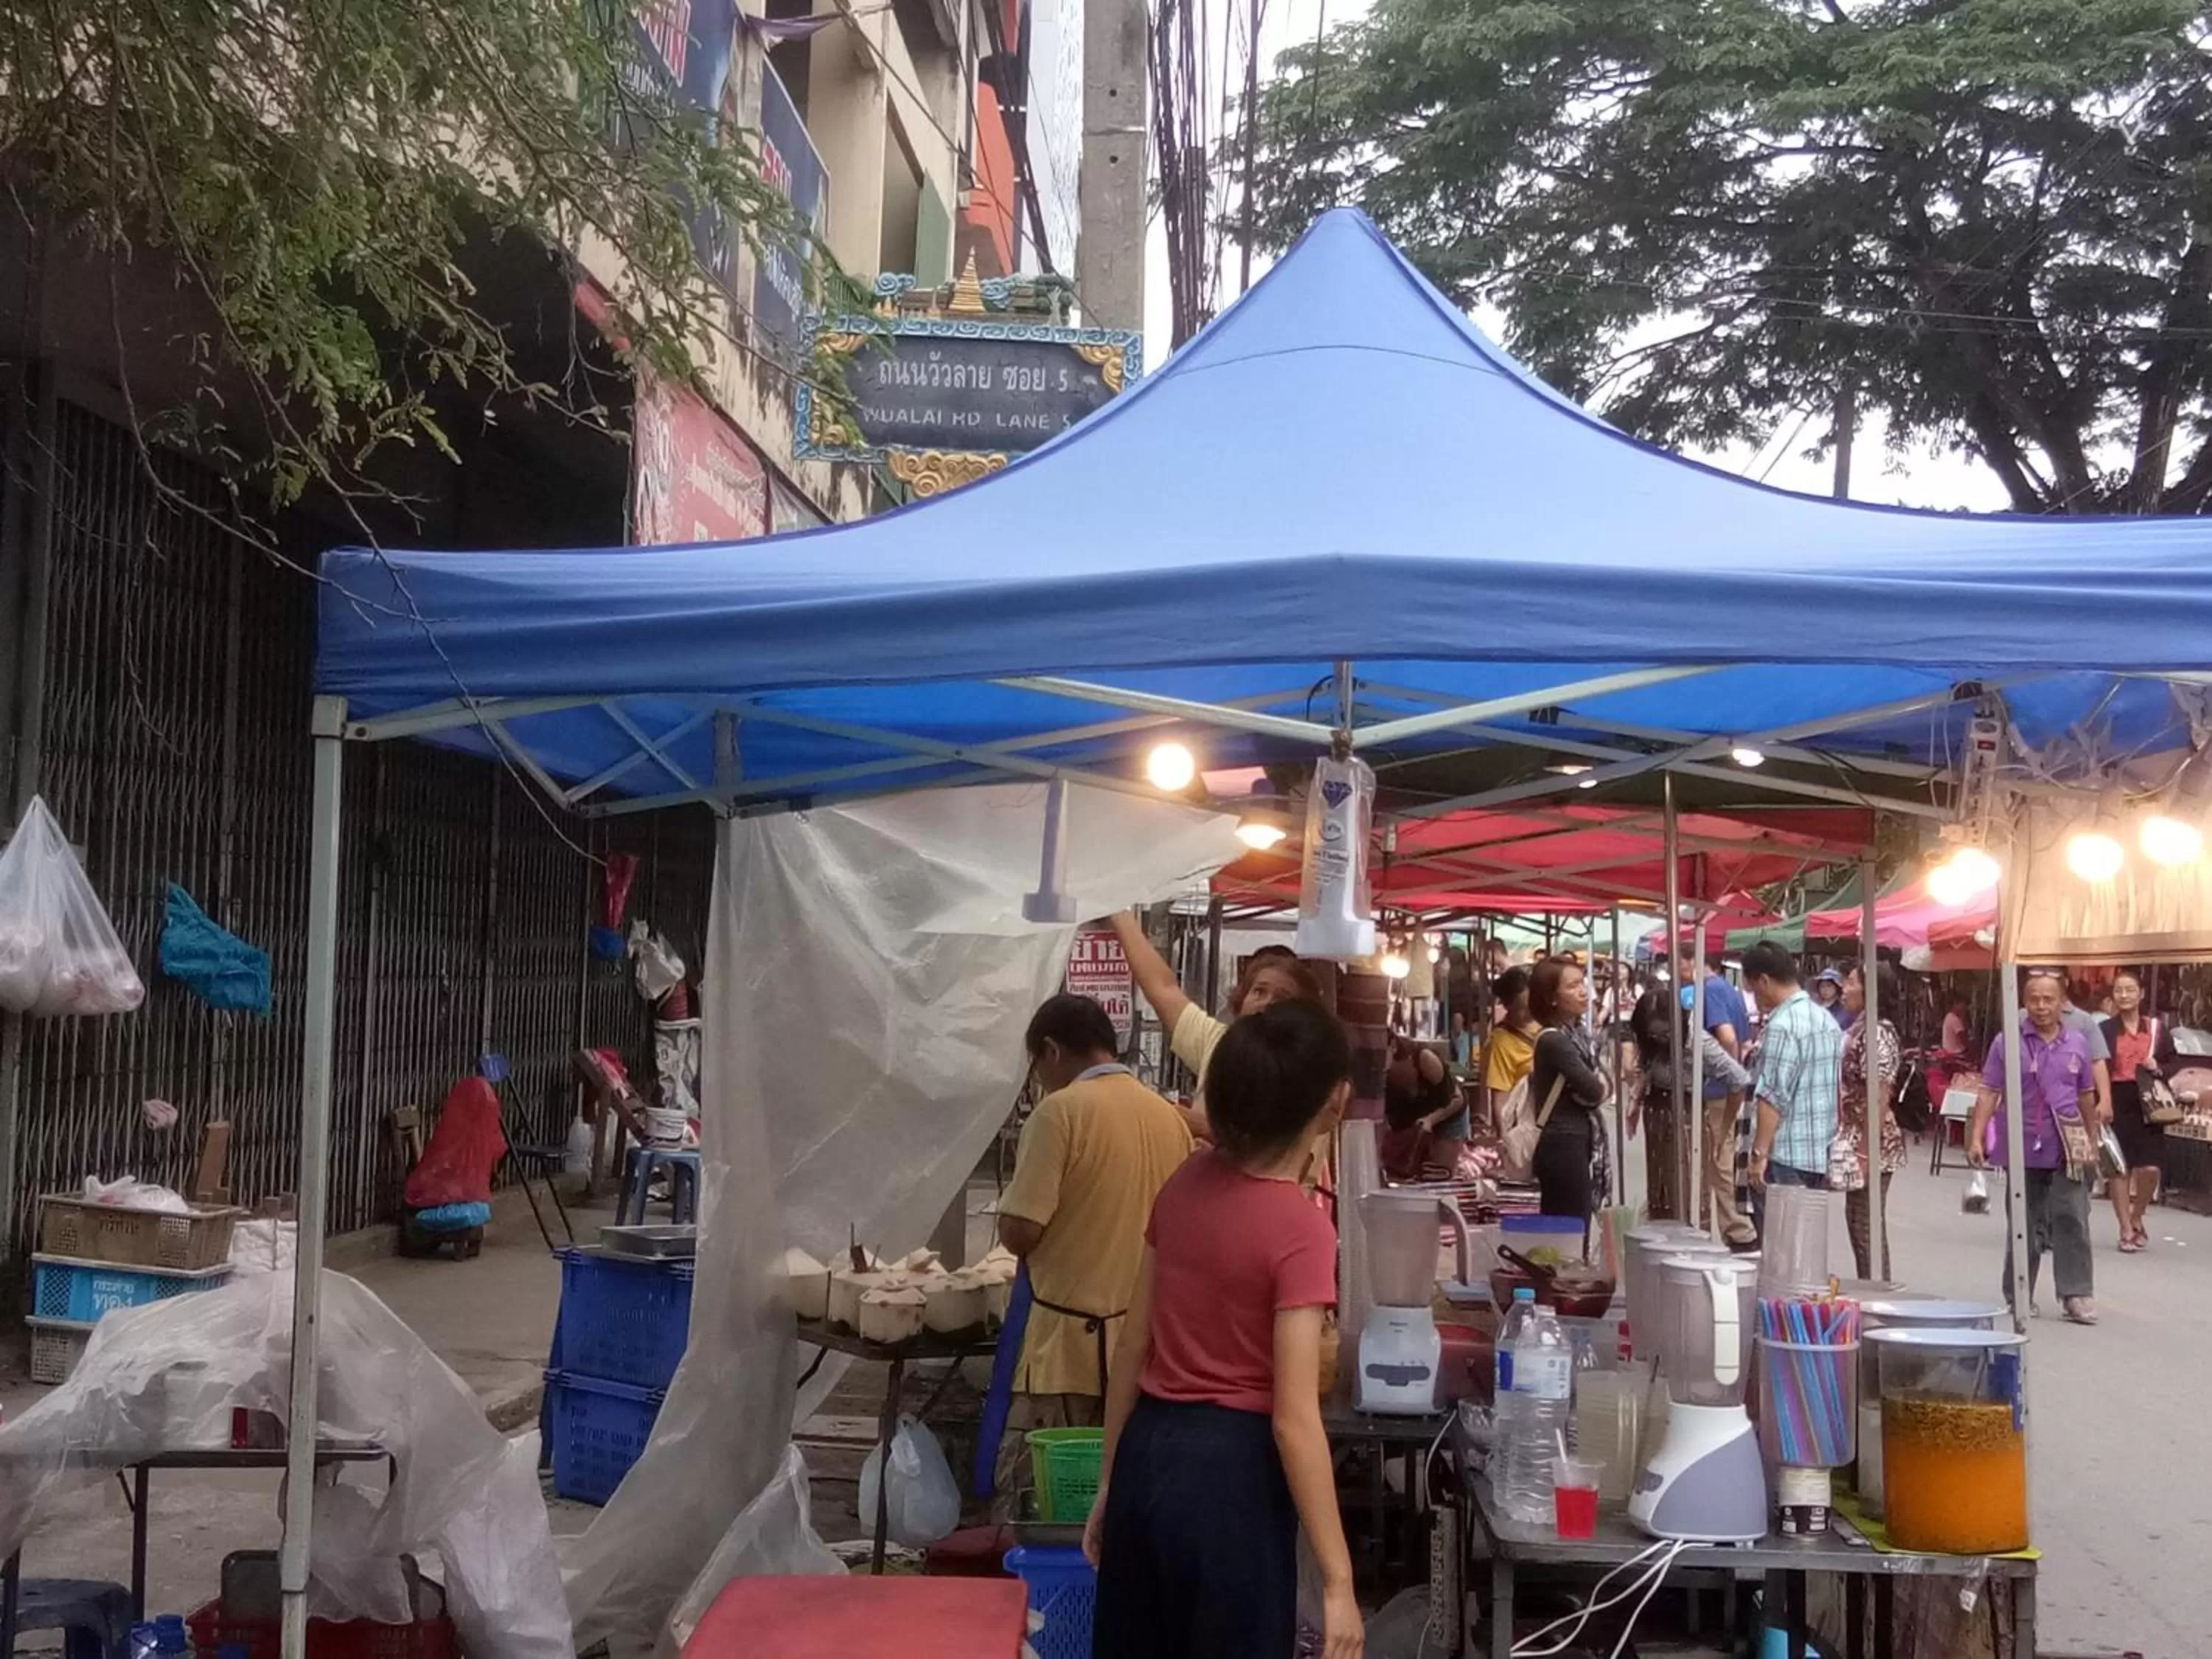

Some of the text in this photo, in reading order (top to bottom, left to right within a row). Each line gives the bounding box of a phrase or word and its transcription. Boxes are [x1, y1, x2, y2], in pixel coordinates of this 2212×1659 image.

[879, 350, 1068, 392] ถนนวัวลาย ซอย 5
[863, 408, 942, 425] WUALAI
[995, 412, 1051, 429] LANE
